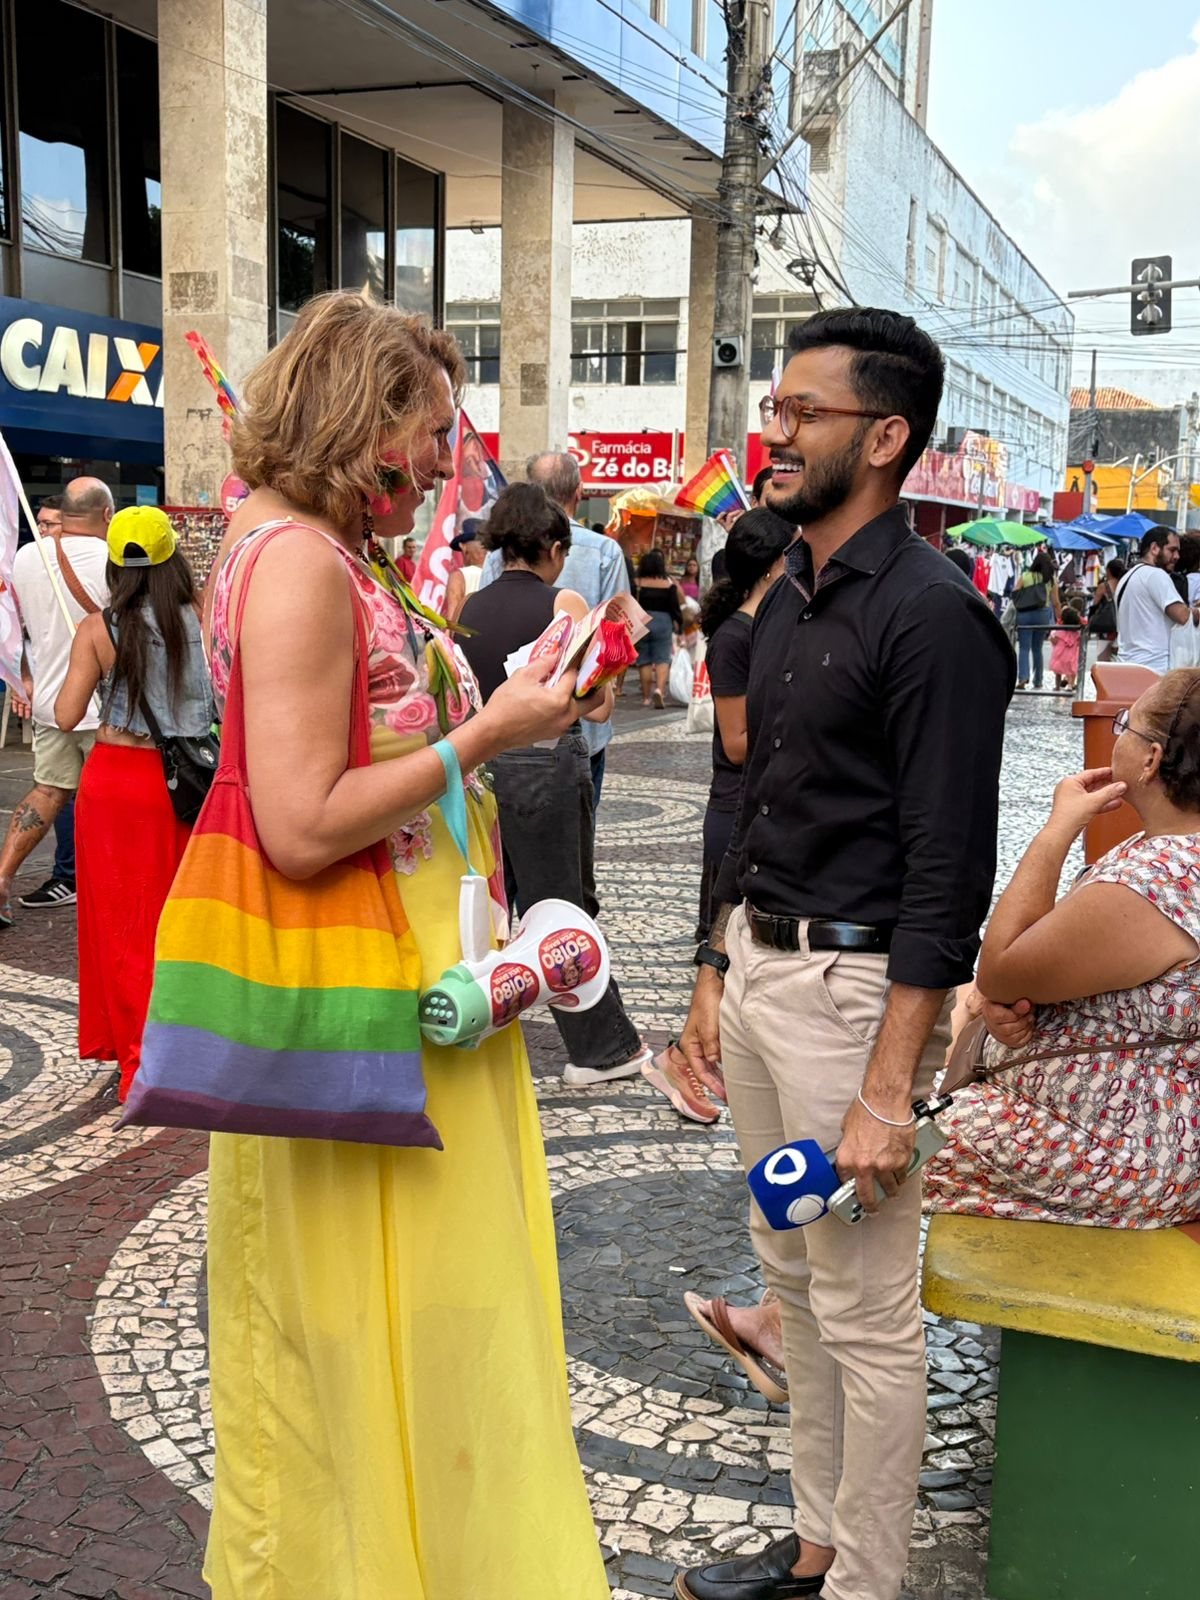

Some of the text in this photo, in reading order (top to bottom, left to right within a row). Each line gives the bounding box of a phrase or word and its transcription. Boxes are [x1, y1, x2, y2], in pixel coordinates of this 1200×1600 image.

[0, 317, 164, 408] CAIX
[591, 440, 652, 454] Farmácia
[592, 457, 619, 477] Zé
[622, 457, 651, 477] do
[541, 934, 592, 970] 50180
[492, 970, 535, 1005] 50180
